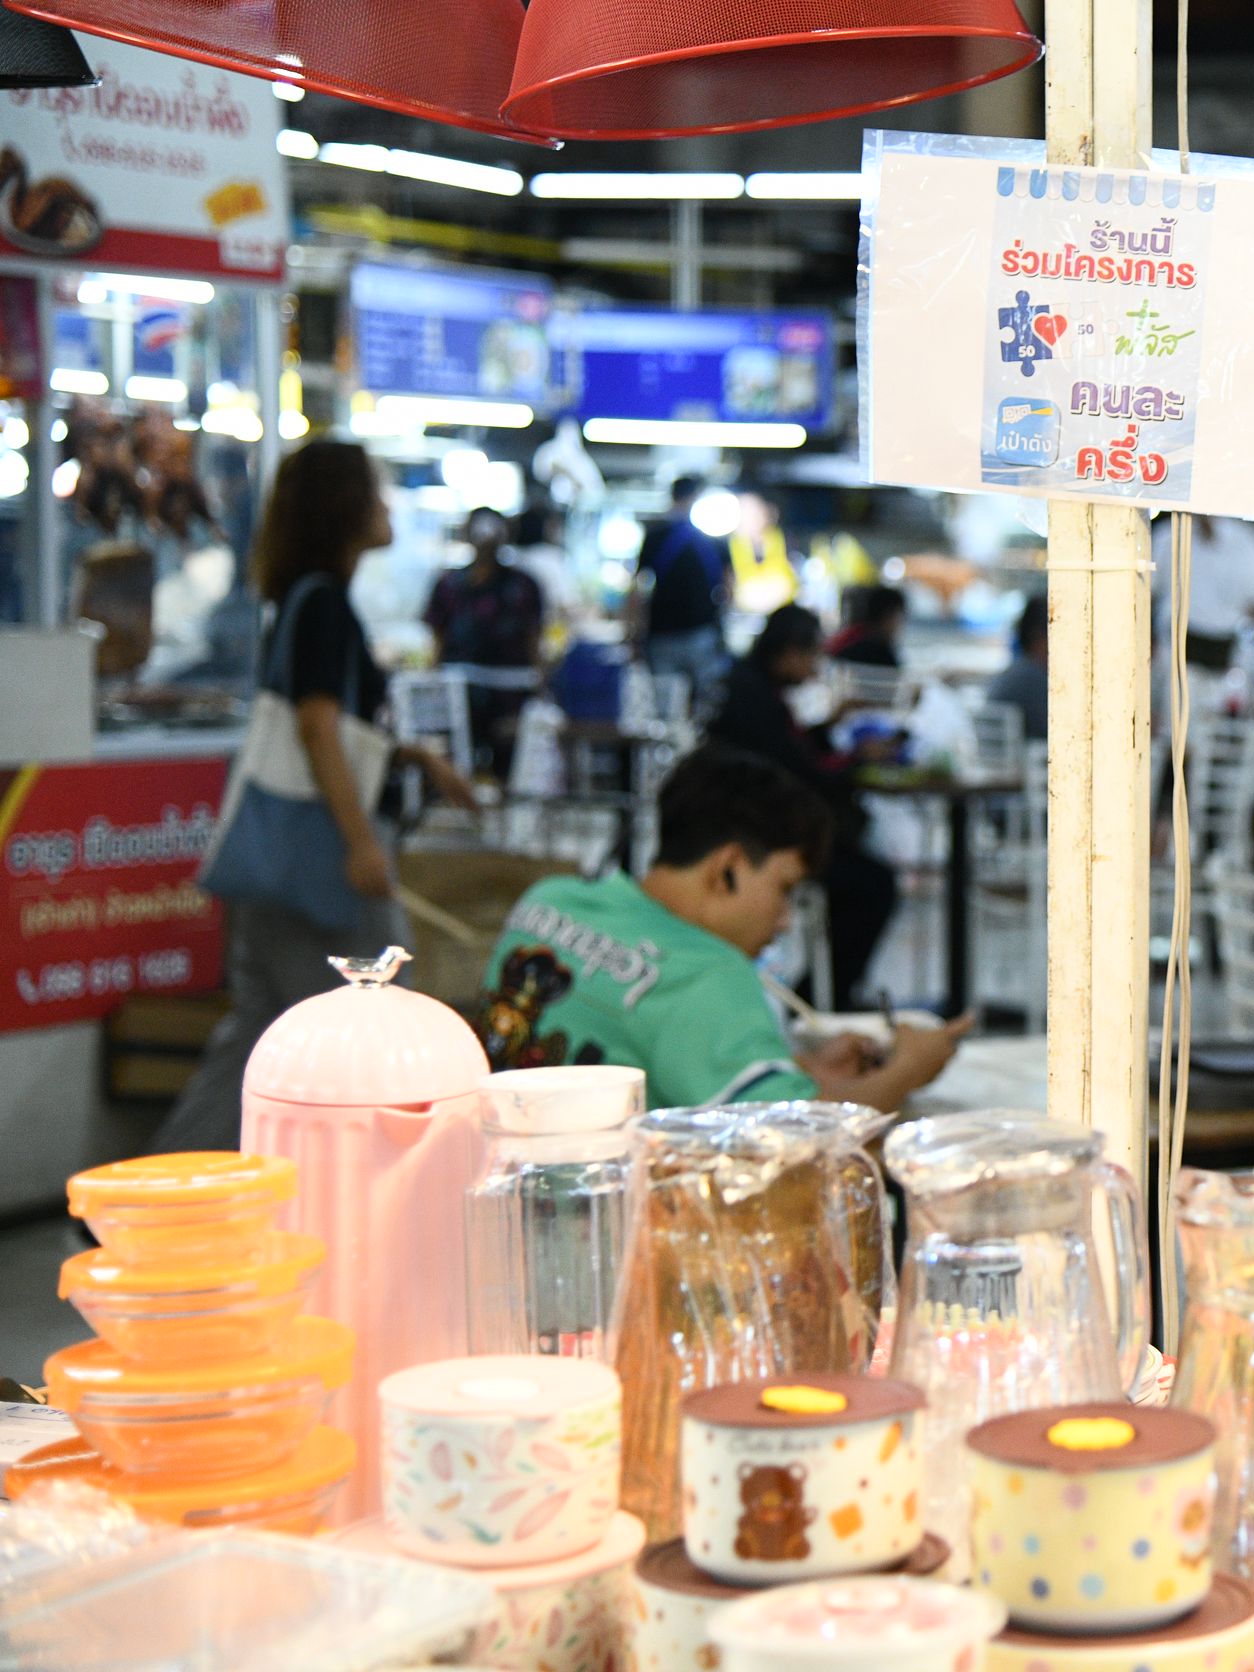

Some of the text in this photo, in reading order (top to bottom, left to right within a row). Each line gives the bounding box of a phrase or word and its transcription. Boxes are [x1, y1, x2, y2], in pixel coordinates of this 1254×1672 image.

[1089, 217, 1178, 256] ร้านนี้
[1000, 239, 1198, 288] ร่วมโครงการ
[1077, 323, 1094, 336] 50
[1017, 344, 1036, 358] 50
[1069, 380, 1184, 421] คนละ
[999, 429, 1053, 453] เป๋าตัง
[1075, 423, 1168, 486] ครึ่ง
